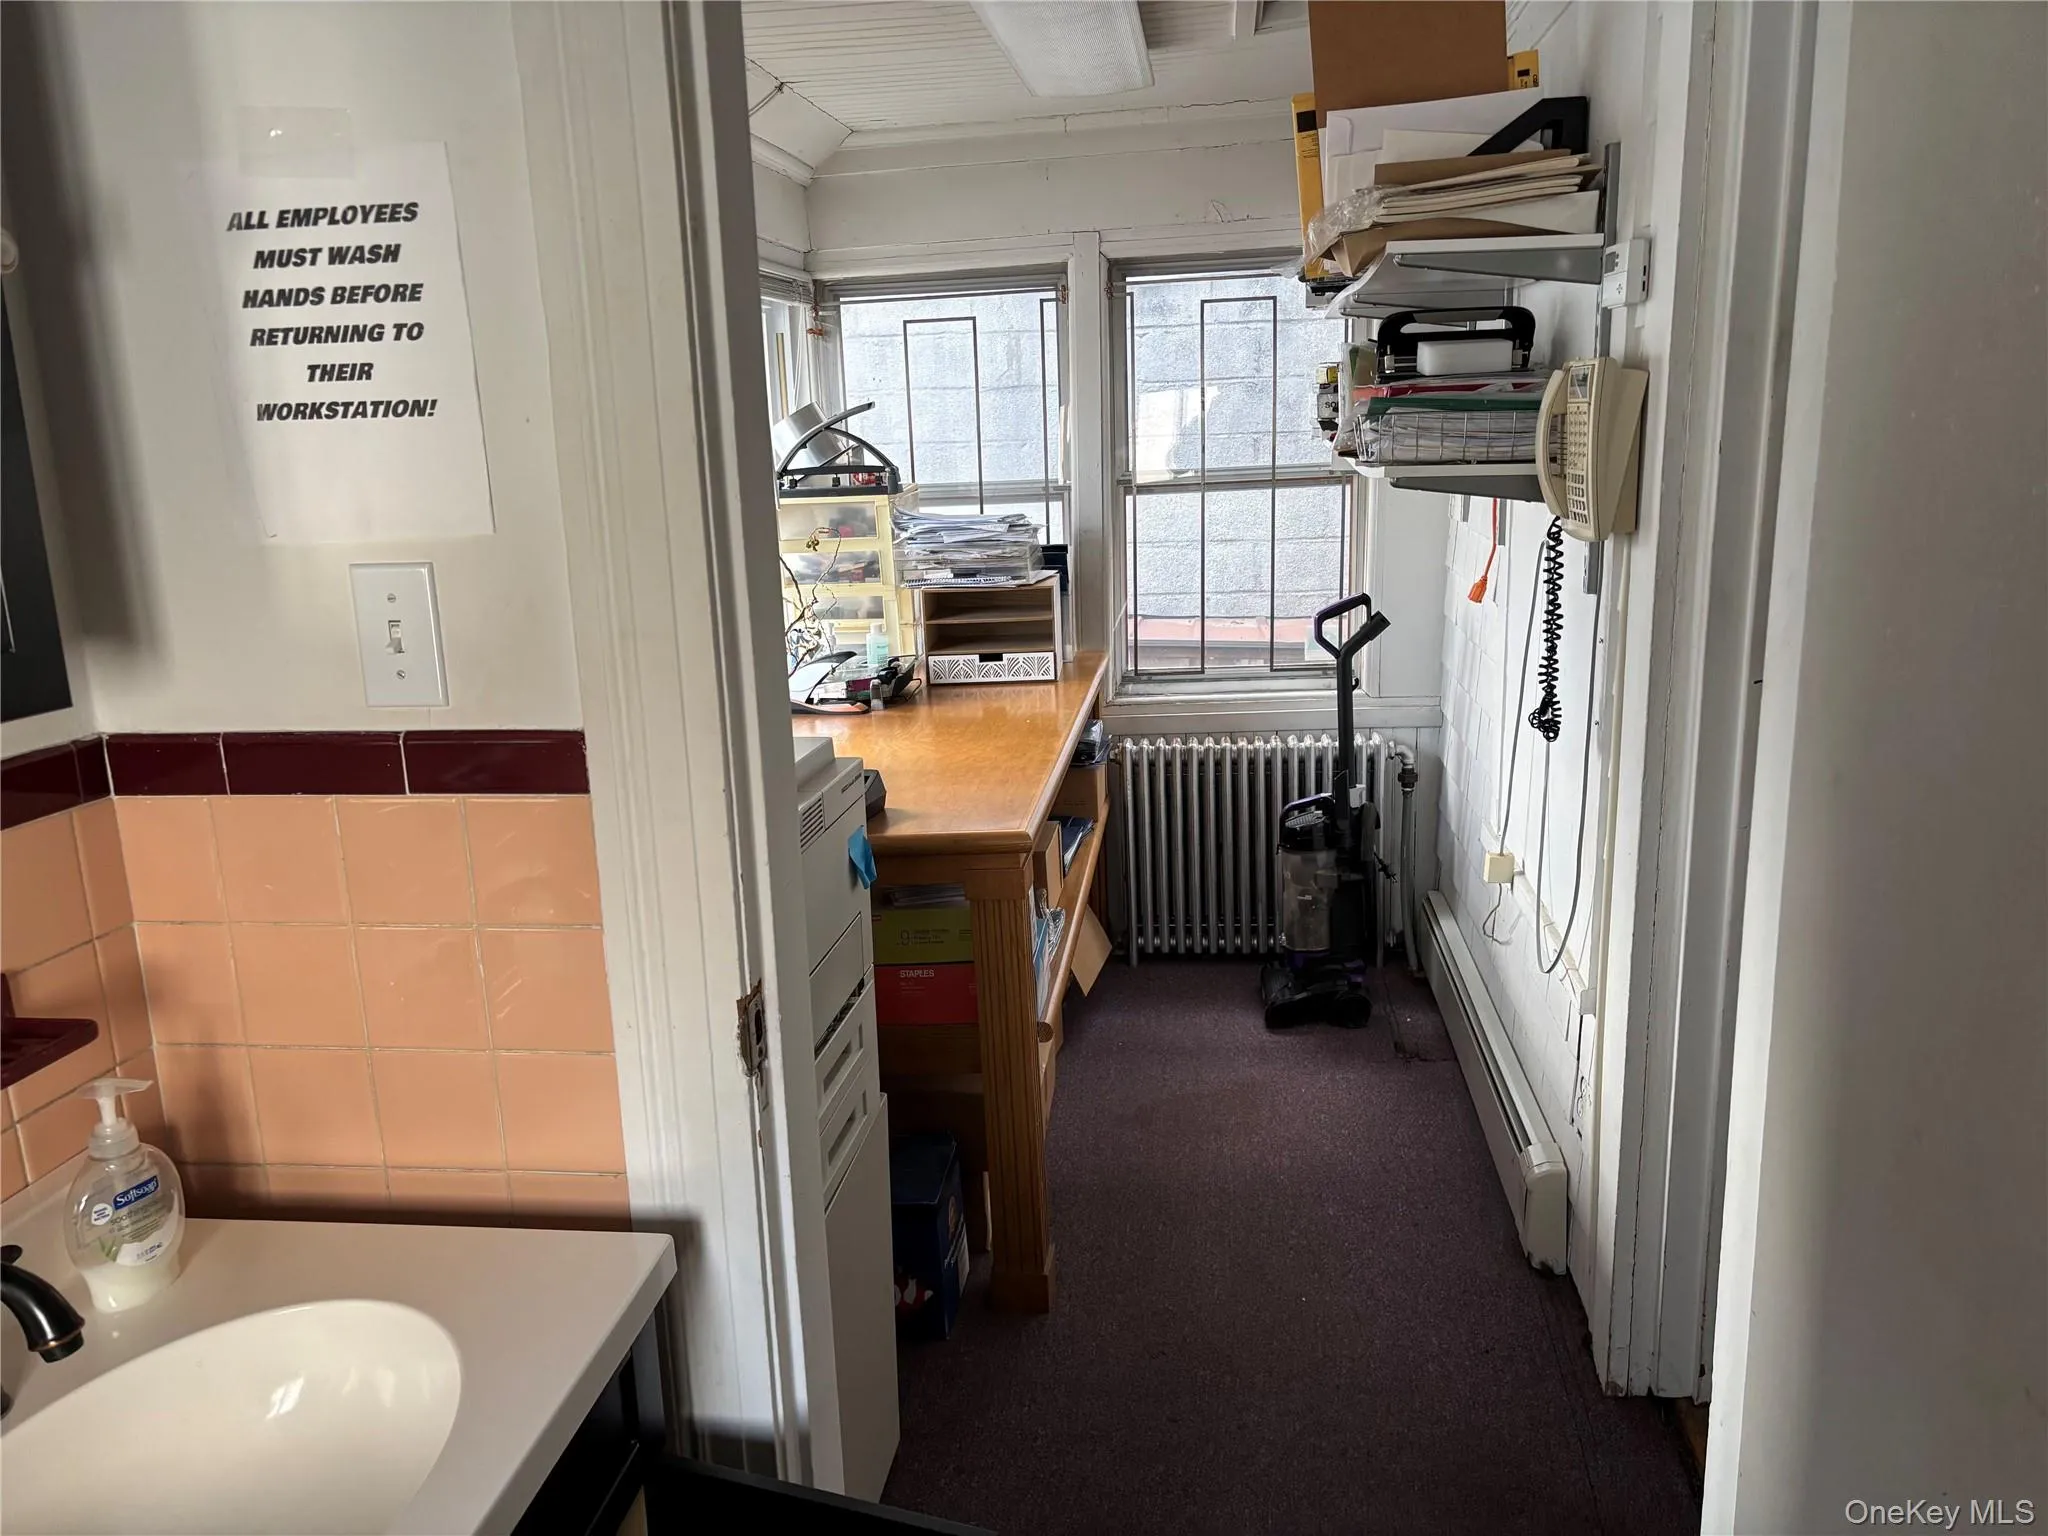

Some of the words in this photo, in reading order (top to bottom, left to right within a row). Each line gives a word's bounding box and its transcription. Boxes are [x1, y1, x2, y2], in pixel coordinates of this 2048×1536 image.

[226, 210, 270, 232] ALL
[275, 201, 420, 229] EMPLOYEES
[253, 247, 323, 269] MUST
[327, 243, 402, 266] WASH
[242, 286, 326, 309] HANDS
[330, 282, 424, 305] BEFORE
[249, 323, 386, 347] RETURNING
[392, 322, 425, 342] TO
[306, 362, 374, 383] THEIR
[256, 398, 438, 422] WORKSTATION!
[900, 969, 935, 978] STAPLES
[116, 1178, 157, 1205] Softsoap
